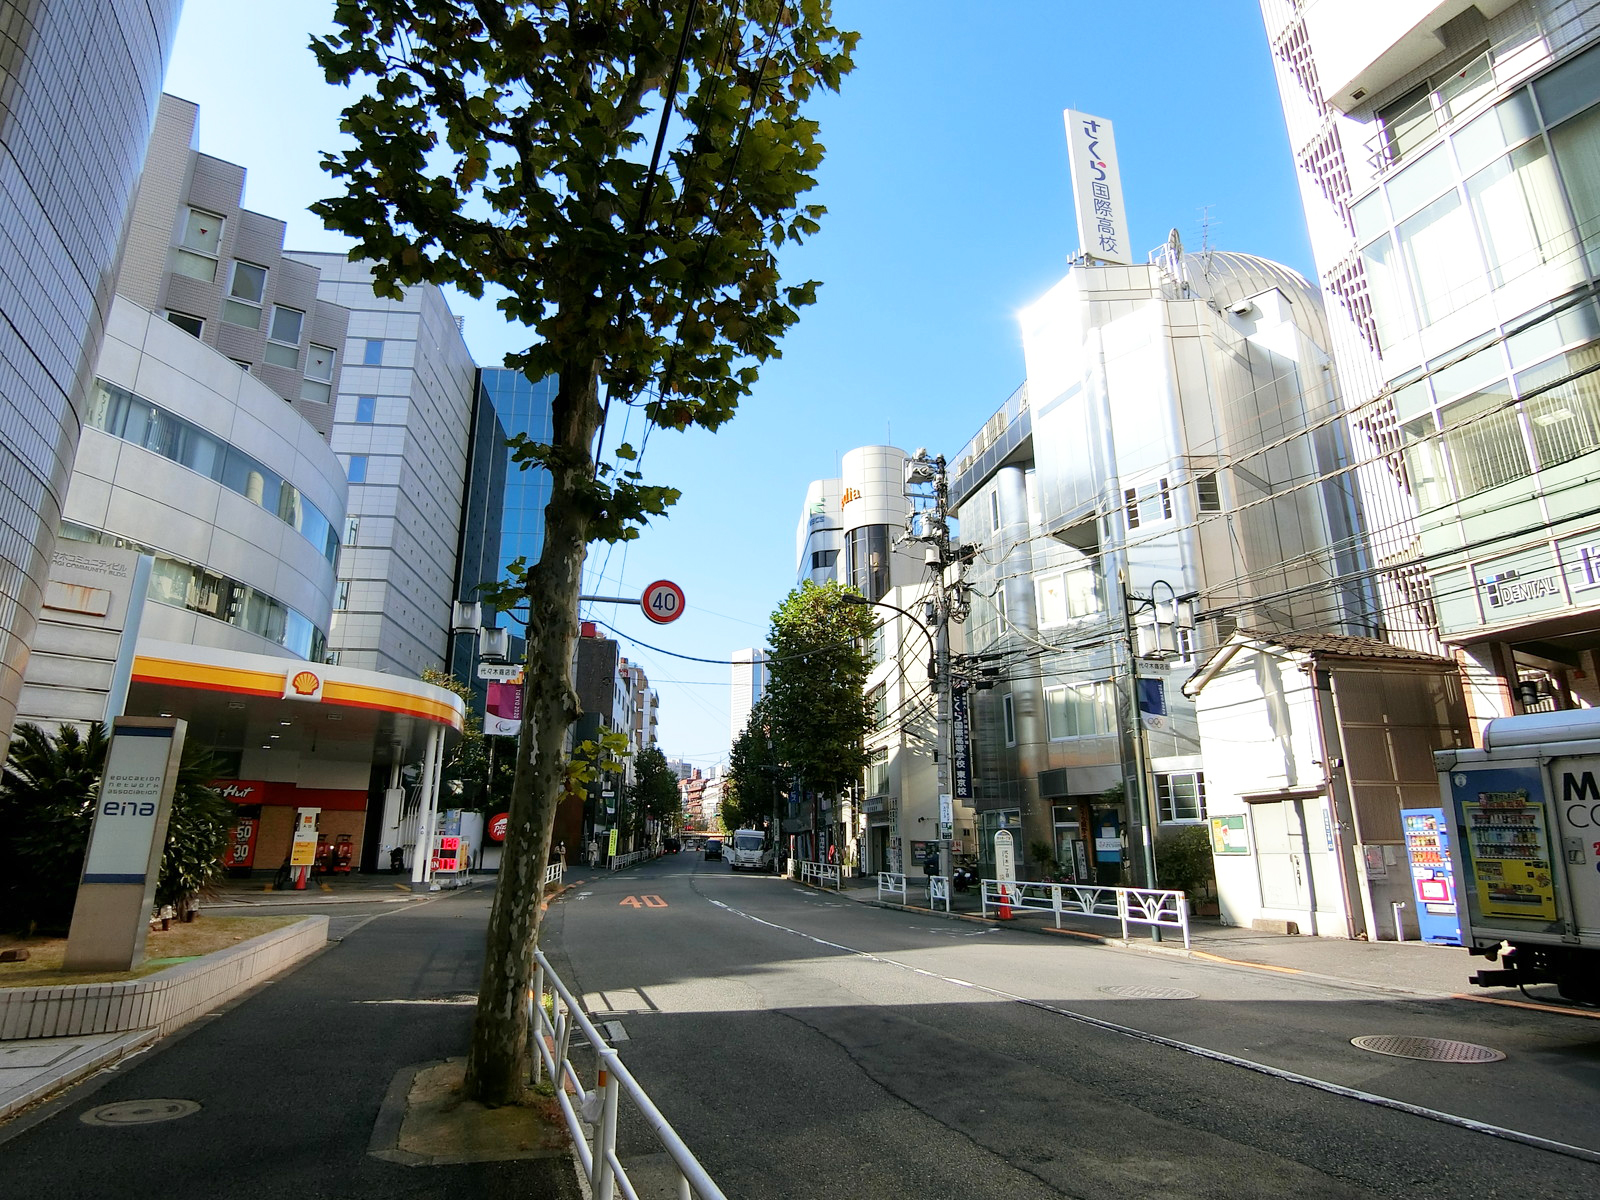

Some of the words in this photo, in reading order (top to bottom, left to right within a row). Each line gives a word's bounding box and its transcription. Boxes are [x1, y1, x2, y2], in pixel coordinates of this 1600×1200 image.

[1082, 119, 1119, 255] さくら国際高校
[1500, 576, 1560, 605] DENTAL
[652, 592, 676, 611] 40
[956, 770, 968, 796] 東京校
[223, 785, 255, 798] Hut
[237, 825, 252, 838] 50
[233, 844, 249, 858] 30
[442, 838, 459, 850] 128
[619, 895, 669, 909] 40
